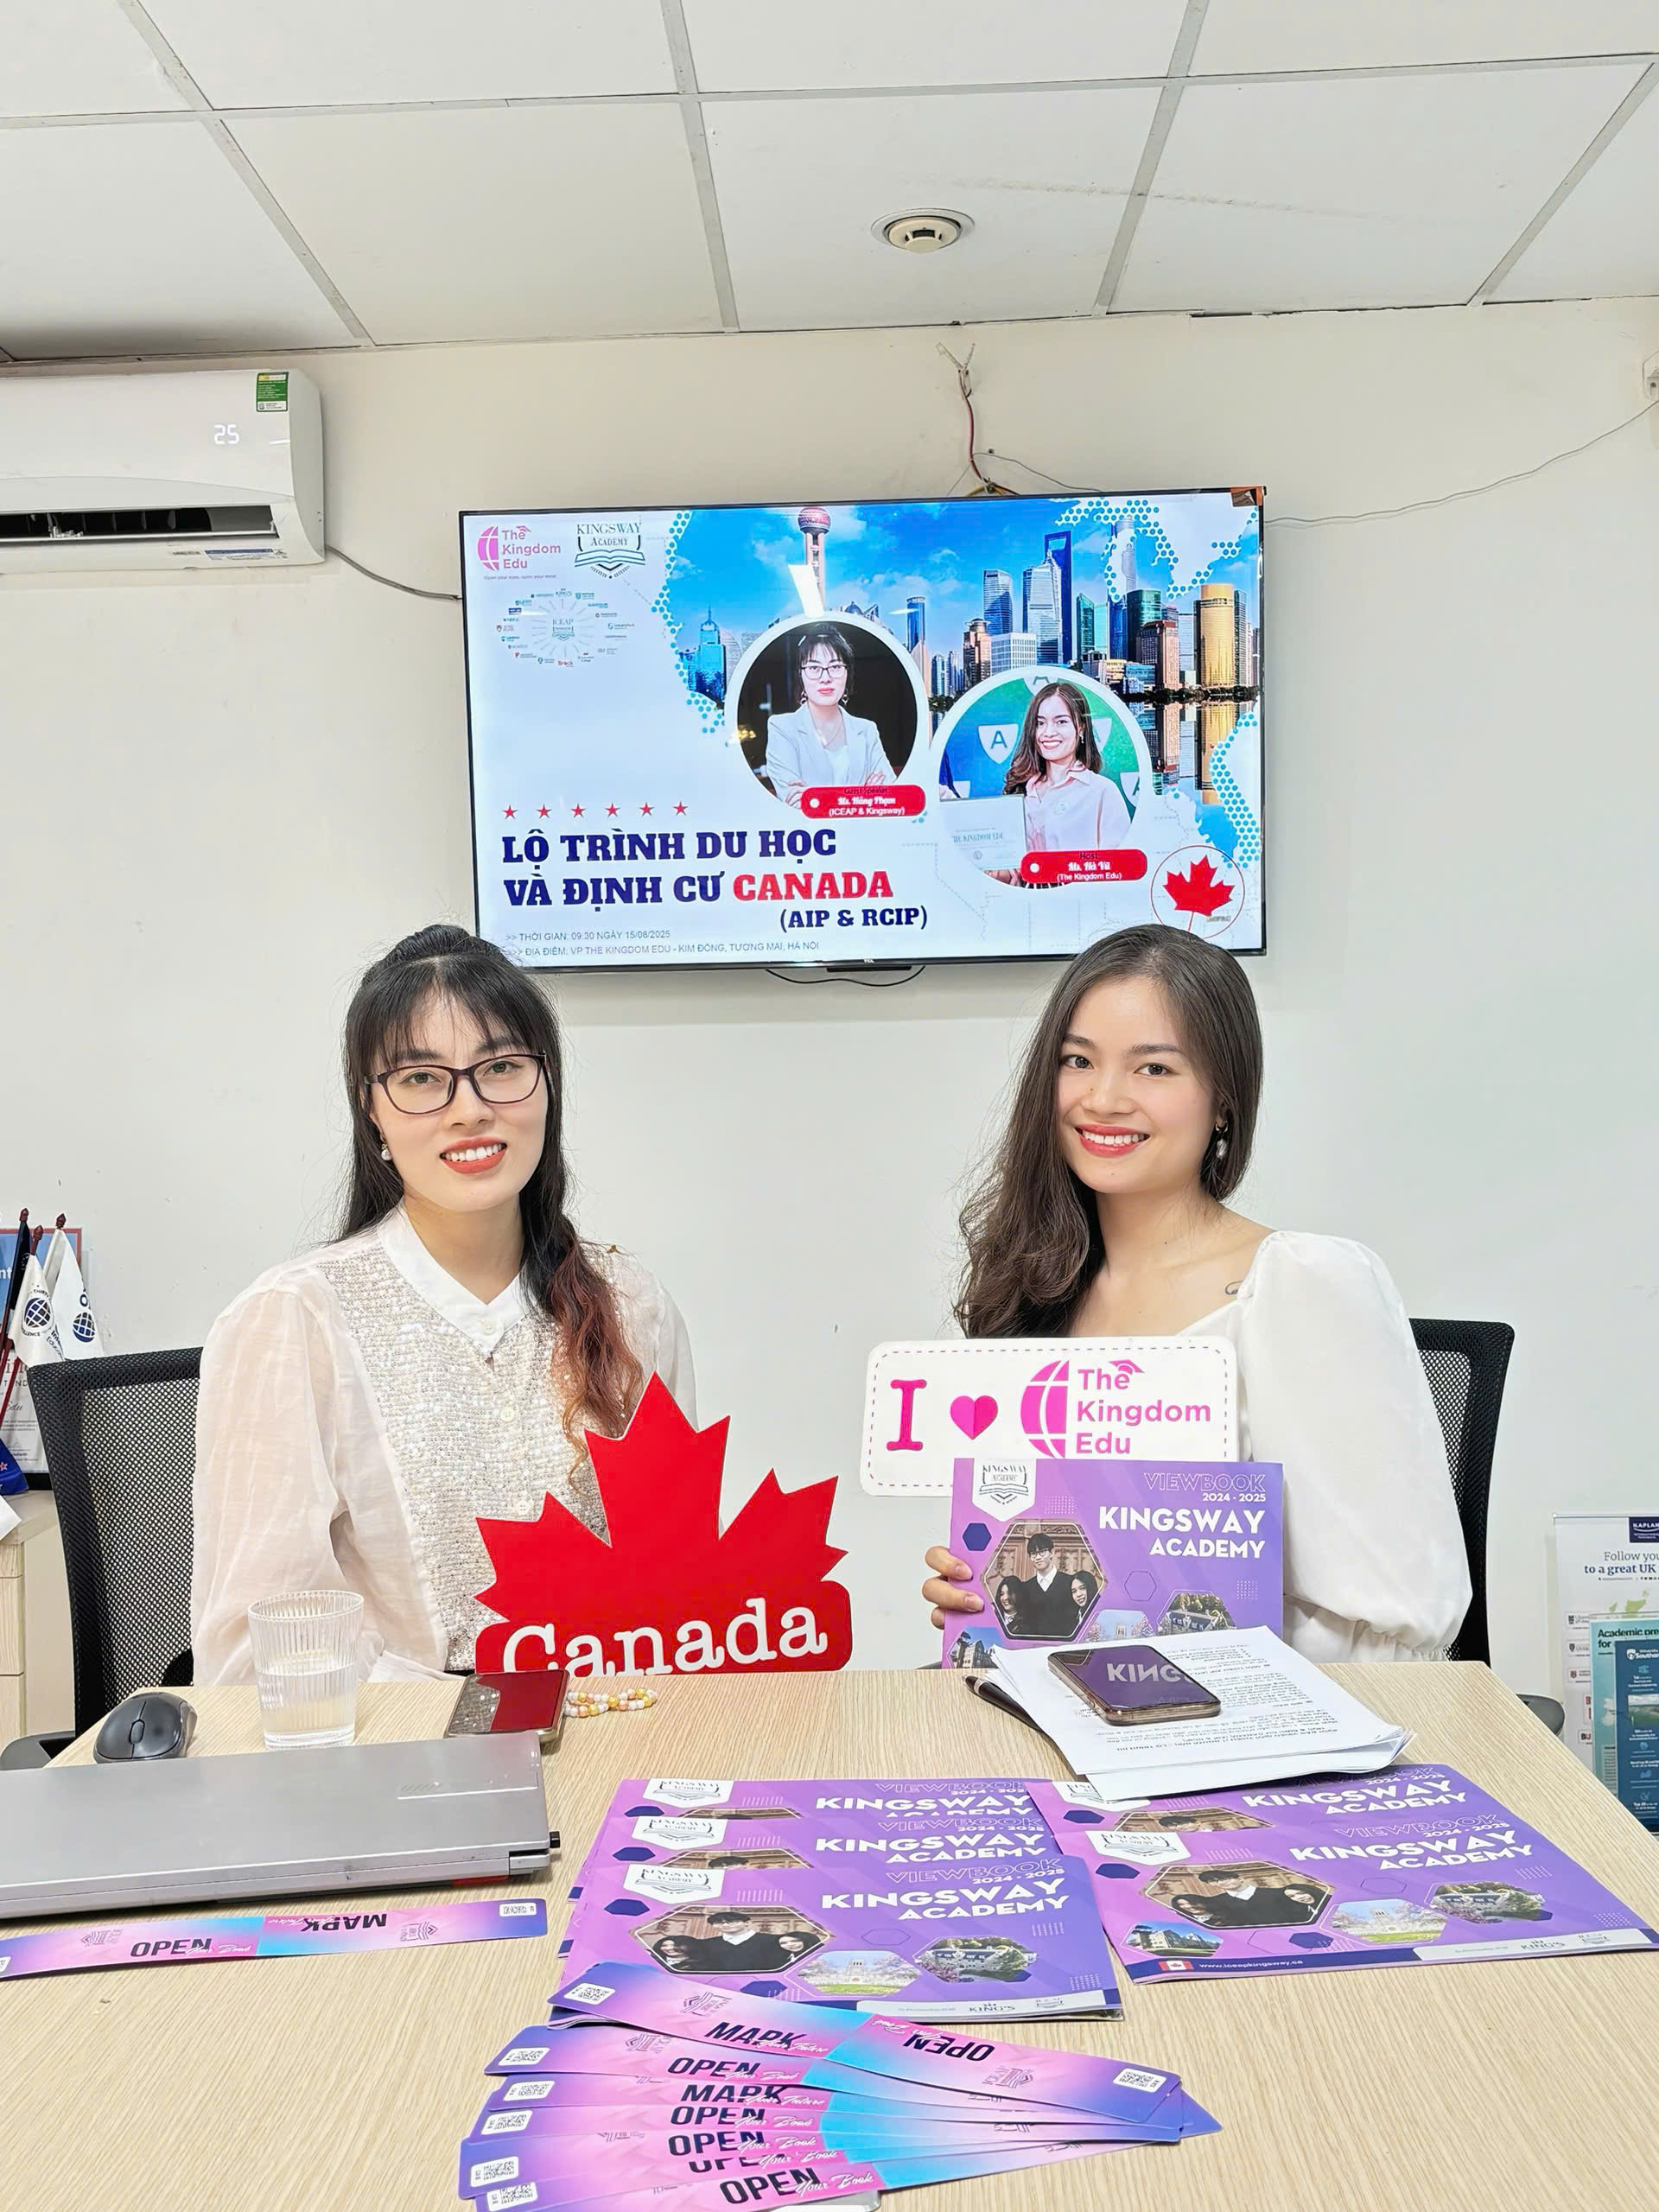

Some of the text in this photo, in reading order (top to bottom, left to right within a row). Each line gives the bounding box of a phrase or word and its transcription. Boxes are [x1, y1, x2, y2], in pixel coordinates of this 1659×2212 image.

[214, 424, 239, 444] 25
[502, 529, 526, 540] The
[576, 523, 641, 535] KINGSWAY
[502, 543, 561, 556] Kingdom
[590, 537, 628, 546] ACADEMY
[503, 559, 527, 569] Edu
[990, 730, 1007, 750] A
[830, 808, 857, 817] (ICEAP
[867, 807, 905, 816] Kingsway)
[502, 828, 836, 870] LỘ TRÌNH DU HỌC
[1074, 873, 1103, 881] Kingdom
[1106, 872, 1122, 880] Edu)
[503, 870, 893, 912] VÀ ĐỊNH CƯ CANADA
[779, 905, 928, 933] (AIP & RCIP)
[626, 930, 671, 939] 15/08/2025
[585, 946, 603, 955] THE
[606, 945, 649, 955] KINGDOM
[652, 944, 671, 953] EDU
[1077, 1369, 1130, 1390] The
[886, 1379, 1211, 1452] I Kingdom
[1076, 1433, 1130, 1454] Edu
[1144, 1472, 1266, 1492] VIEWBOOK
[1202, 1492, 1230, 1502] 2024
[1238, 1492, 1267, 1503] 2025
[1099, 1506, 1266, 1535] KINGSWAY
[1149, 1538, 1266, 1560] ACADEMY
[1604, 1550, 1640, 1561] Follow
[1585, 1565, 1596, 1573] to
[1607, 1565, 1637, 1576] great
[1639, 1564, 1656, 1573] UK
[503, 1597, 828, 1676] Canada
[1598, 1627, 1643, 1638] Academic
[1598, 1639, 1611, 1648] for
[816, 1795, 1031, 1810] KINGSWAY
[1243, 1780, 1452, 1808] KINGSWAY
[1325, 1791, 1467, 1815] ACADEMY
[878, 1817, 1043, 1832] VIEWBOOK
[1333, 1814, 1507, 1839] VIEWBOOK
[1422, 1828, 1461, 1838] 2024
[1473, 1822, 1510, 1833] 2025
[816, 1833, 1045, 1853] KINGSWAY
[1288, 1829, 1517, 1861] KINGSWAY
[886, 1847, 1047, 1864] ACADEMY
[1379, 1845, 1534, 1871] ACADEMY
[886, 1857, 1065, 1885] VIEWBOOK
[973, 1875, 1013, 1885] 2024
[1025, 1868, 1065, 1879] 2025
[821, 1877, 1066, 1910] KINGSWAY
[898, 1895, 1070, 1921] ACADEMY
[302, 1913, 387, 1932] MARK
[130, 1938, 213, 1957] OPEN
[704, 2022, 807, 2050] MARK
[903, 2034, 995, 2062] OPEN
[668, 2057, 761, 2078] OPEN
[681, 2084, 792, 2105] MARK
[671, 2106, 766, 2126] OPEN
[668, 2131, 766, 2157] OPEN
[721, 2136, 817, 2155] Your Book
[719, 2167, 823, 2205] OPEN
[778, 2171, 874, 2198] Your Book
